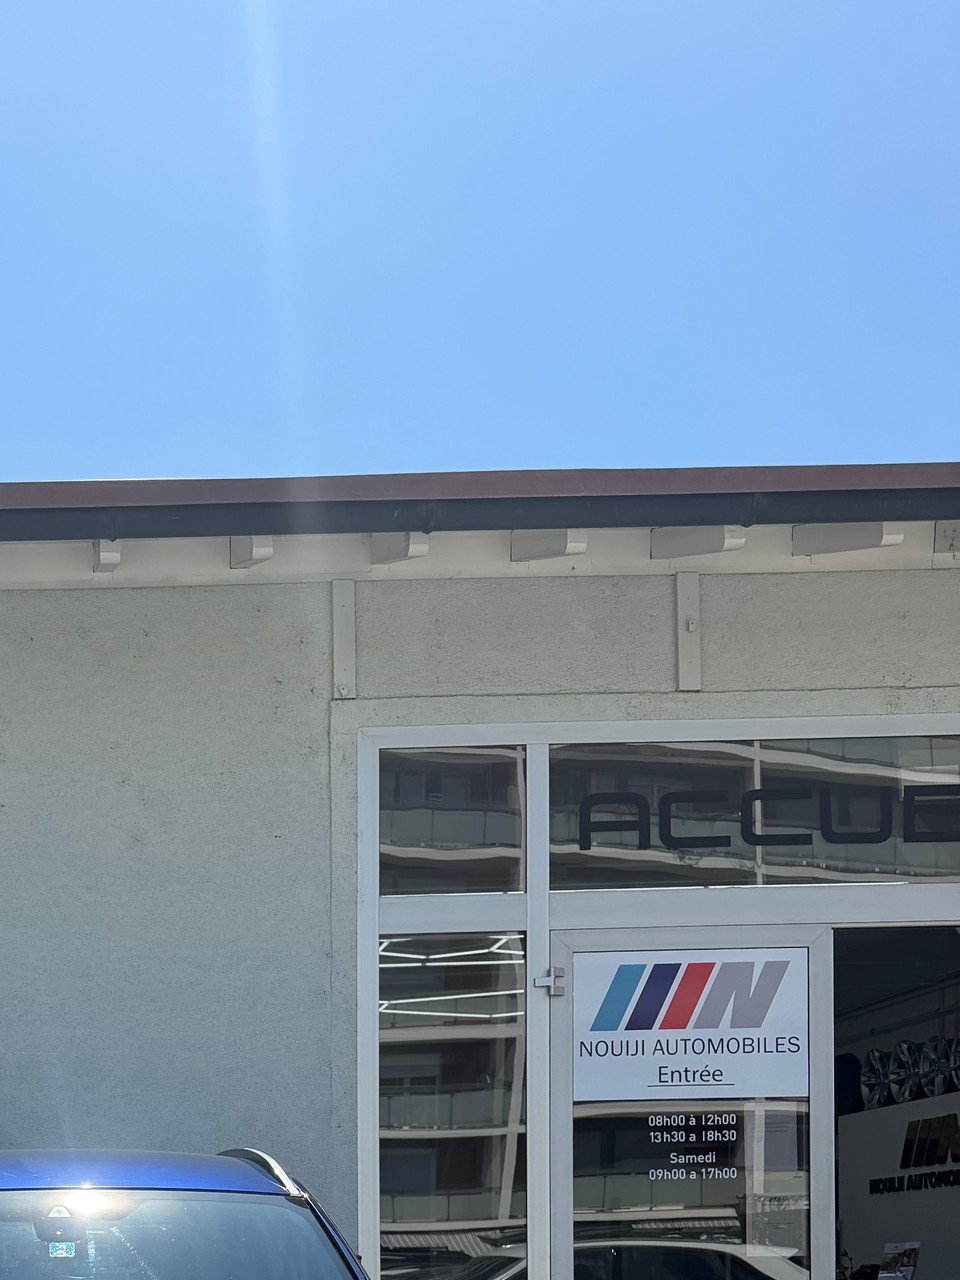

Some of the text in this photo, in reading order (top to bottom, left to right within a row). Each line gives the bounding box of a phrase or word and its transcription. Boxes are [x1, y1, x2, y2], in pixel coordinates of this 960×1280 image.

[579, 1036, 801, 1058] NOUIJI AUTOMOBILES
[658, 1064, 724, 1083] Entrée
[648, 1113, 737, 1127] 08h00 à 12h00
[702, 1130, 737, 1141] 18h30
[669, 1151, 716, 1164] Samedi
[649, 1168, 686, 1180] 09h00
[701, 1167, 737, 1179] 17h00
